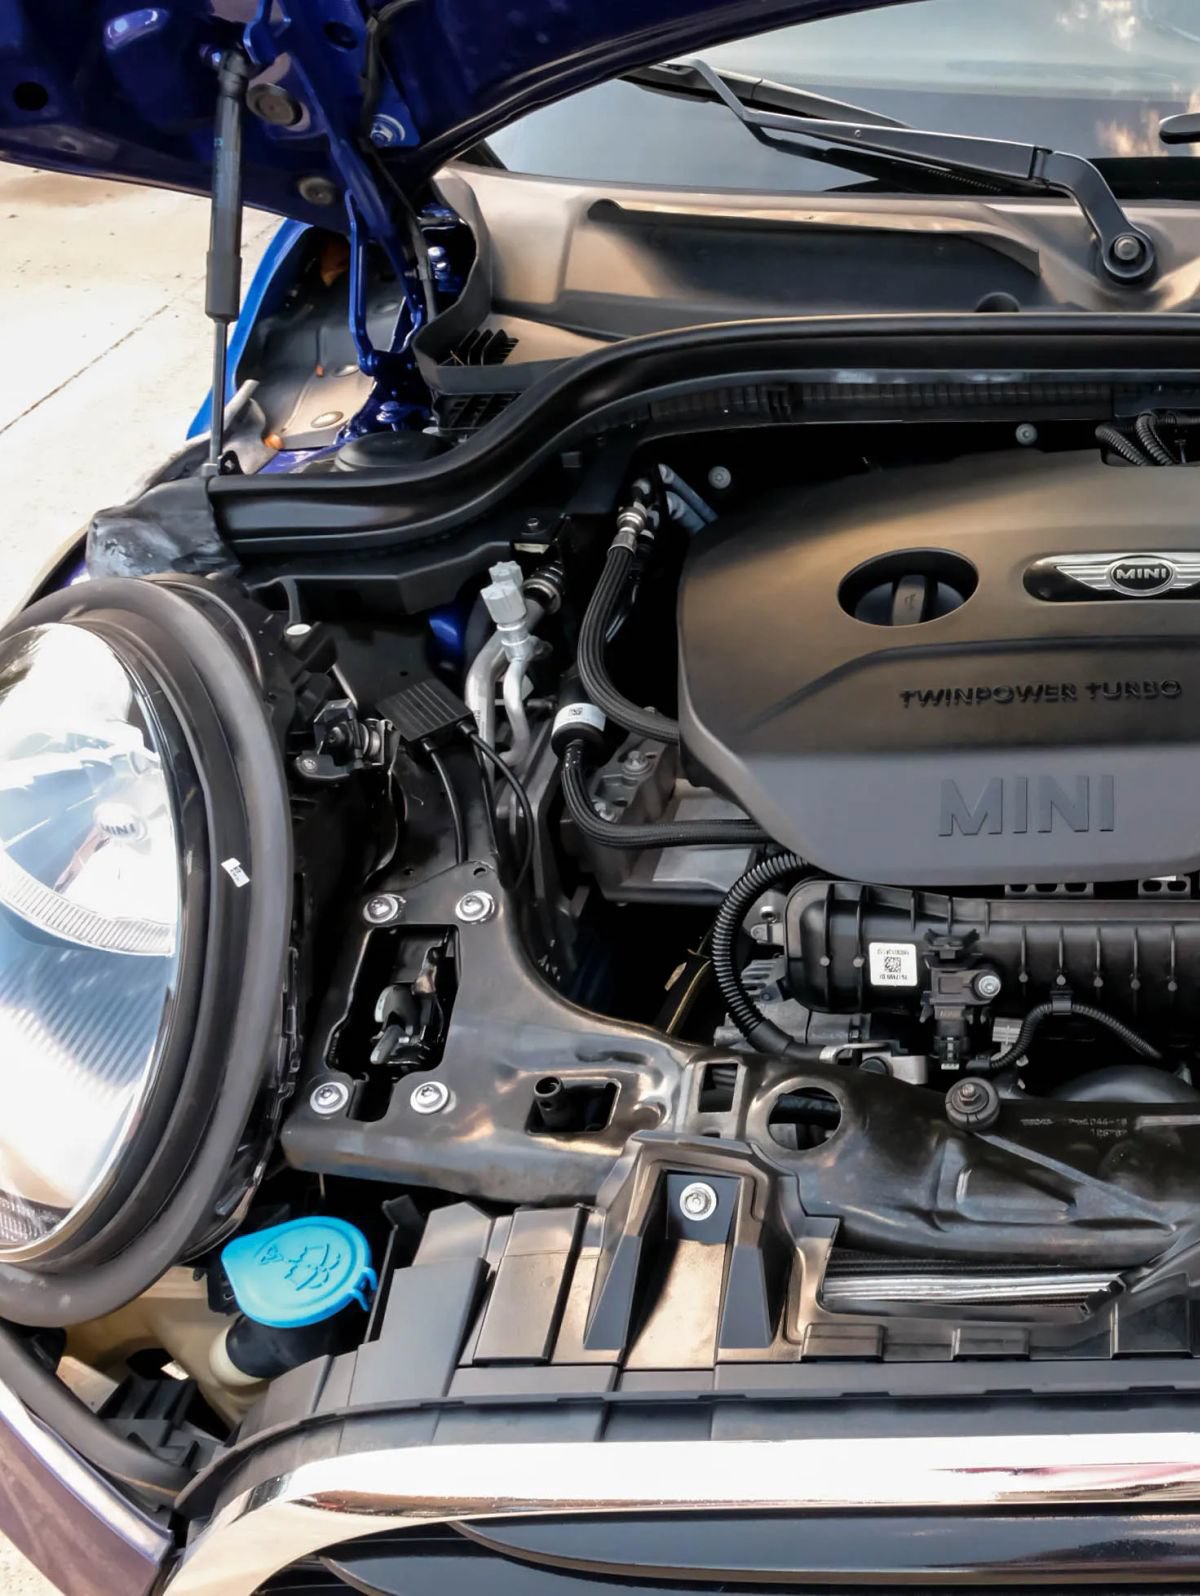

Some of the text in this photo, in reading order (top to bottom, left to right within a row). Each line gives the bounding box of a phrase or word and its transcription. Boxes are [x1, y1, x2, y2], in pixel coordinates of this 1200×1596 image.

[1115, 567, 1167, 580] MINI
[899, 679, 1183, 709] TWINPOWER TURBO
[938, 774, 1115, 838] MINI
